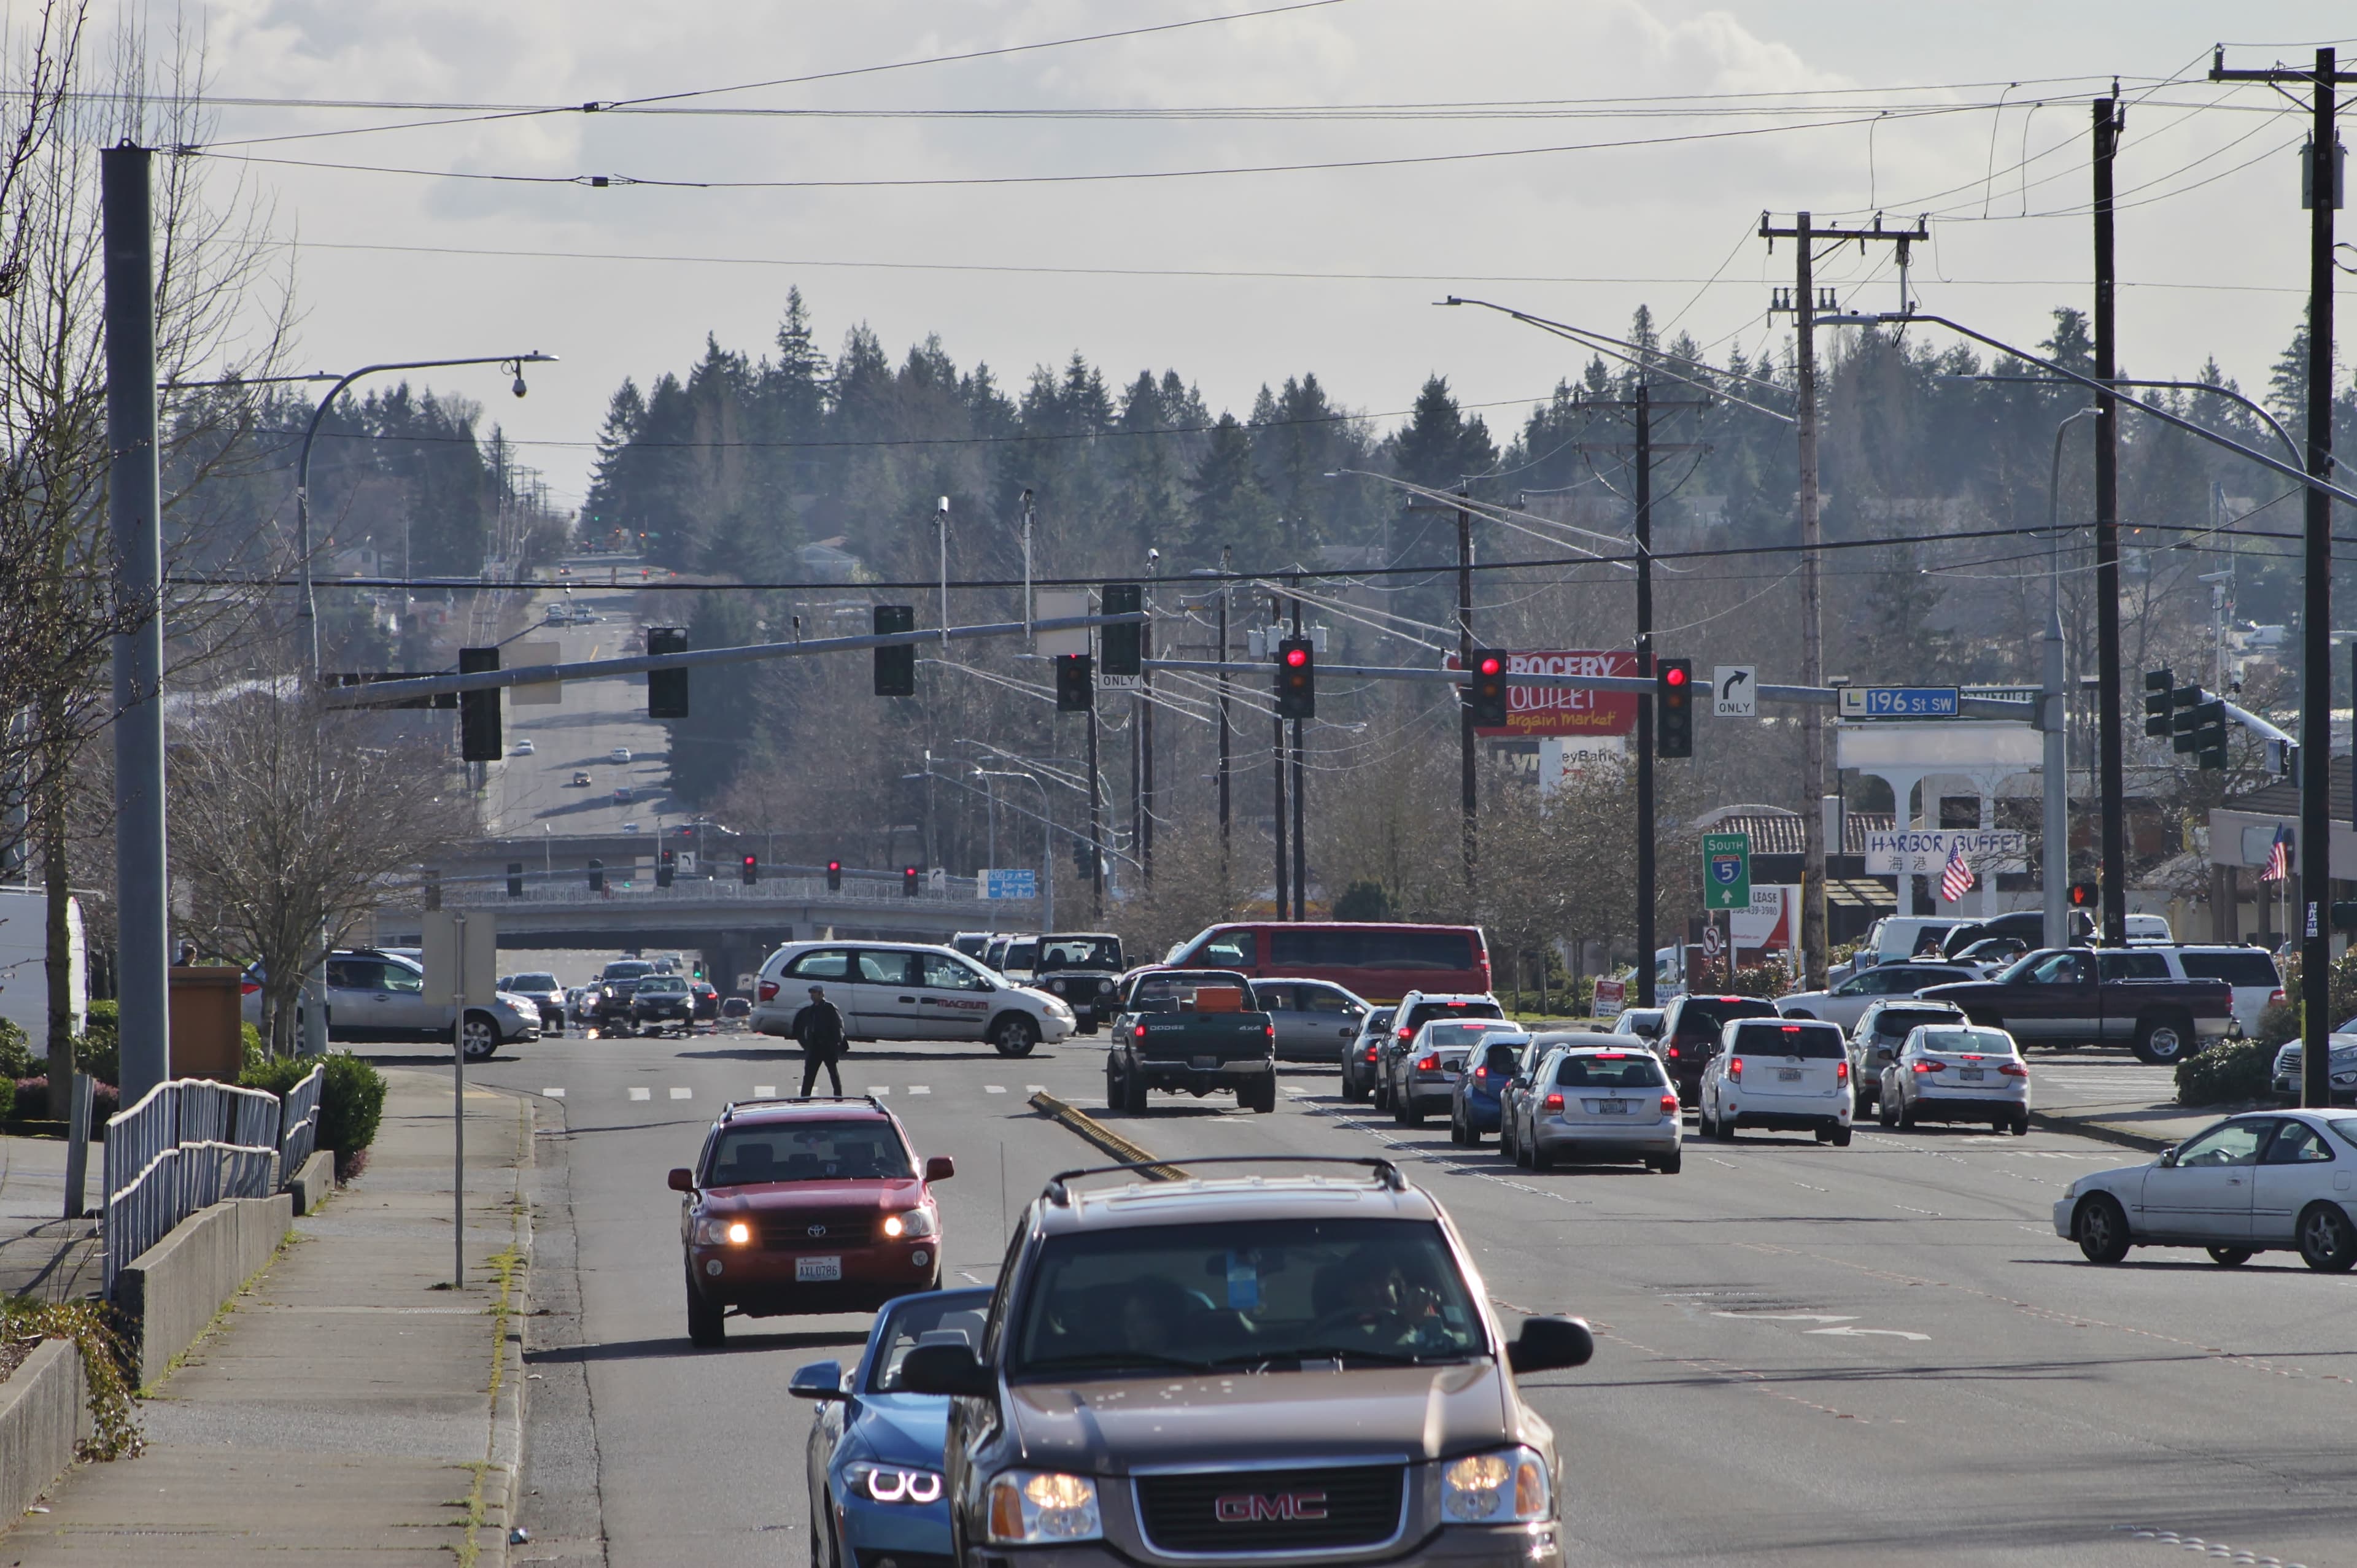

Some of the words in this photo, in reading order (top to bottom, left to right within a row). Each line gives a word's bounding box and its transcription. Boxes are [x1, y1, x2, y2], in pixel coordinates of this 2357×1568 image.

[1506, 656, 1616, 677] ROCERY
[1104, 676, 1135, 686] ONLY
[1719, 703, 1751, 713] ONLY
[1870, 692, 1906, 711] 196
[1912, 698, 1926, 711] St
[1932, 698, 1953, 711] SW
[1506, 713, 1557, 733] argain
[1562, 750, 1617, 763] eyBank
[1708, 840, 1744, 851] SOUTH
[1871, 835, 1945, 853] HARBOR
[1954, 834, 2022, 853] BUFFET
[1721, 863, 1733, 880] 5
[1753, 892, 1777, 903] LEASE
[1215, 1492, 1328, 1522] GMC
